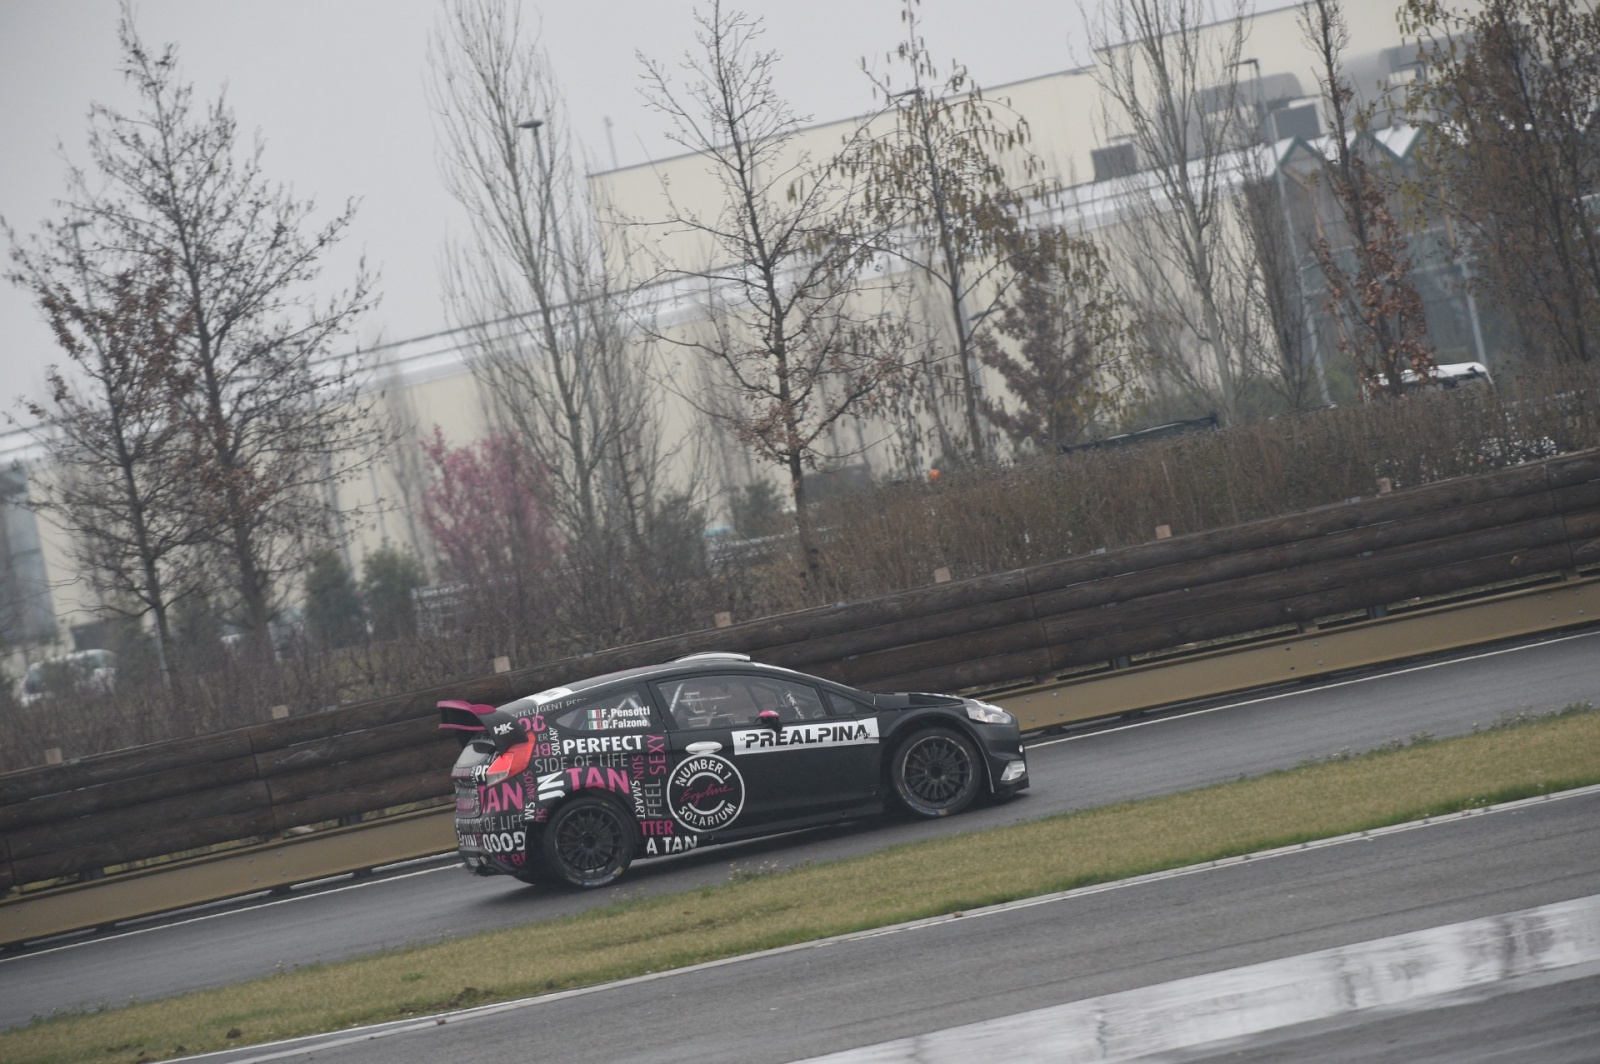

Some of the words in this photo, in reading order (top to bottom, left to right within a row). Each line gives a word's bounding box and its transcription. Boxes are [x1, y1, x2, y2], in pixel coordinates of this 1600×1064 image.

[601, 707, 651, 718] F.Pensotti
[602, 719, 648, 729] G.Falzone
[562, 736, 643, 755] PERFECT
[745, 726, 869, 748] PREALPINA
[534, 758, 568, 773] SIDE
[574, 755, 593, 767] OF
[599, 754, 628, 767] LIFE
[645, 735, 667, 775] SEXY
[631, 755, 645, 780] SUN
[675, 760, 724, 786] NUMBER
[723, 771, 733, 780] 1
[566, 767, 630, 794] TAN
[477, 782, 523, 814] TAN
[630, 781, 646, 820] SMART
[645, 779, 663, 818] FEEL
[679, 784, 734, 807] Ergoline
[678, 803, 737, 827] SOLARIUM
[640, 821, 674, 836] TTER
[646, 838, 659, 855] A
[662, 836, 698, 853] TAN
